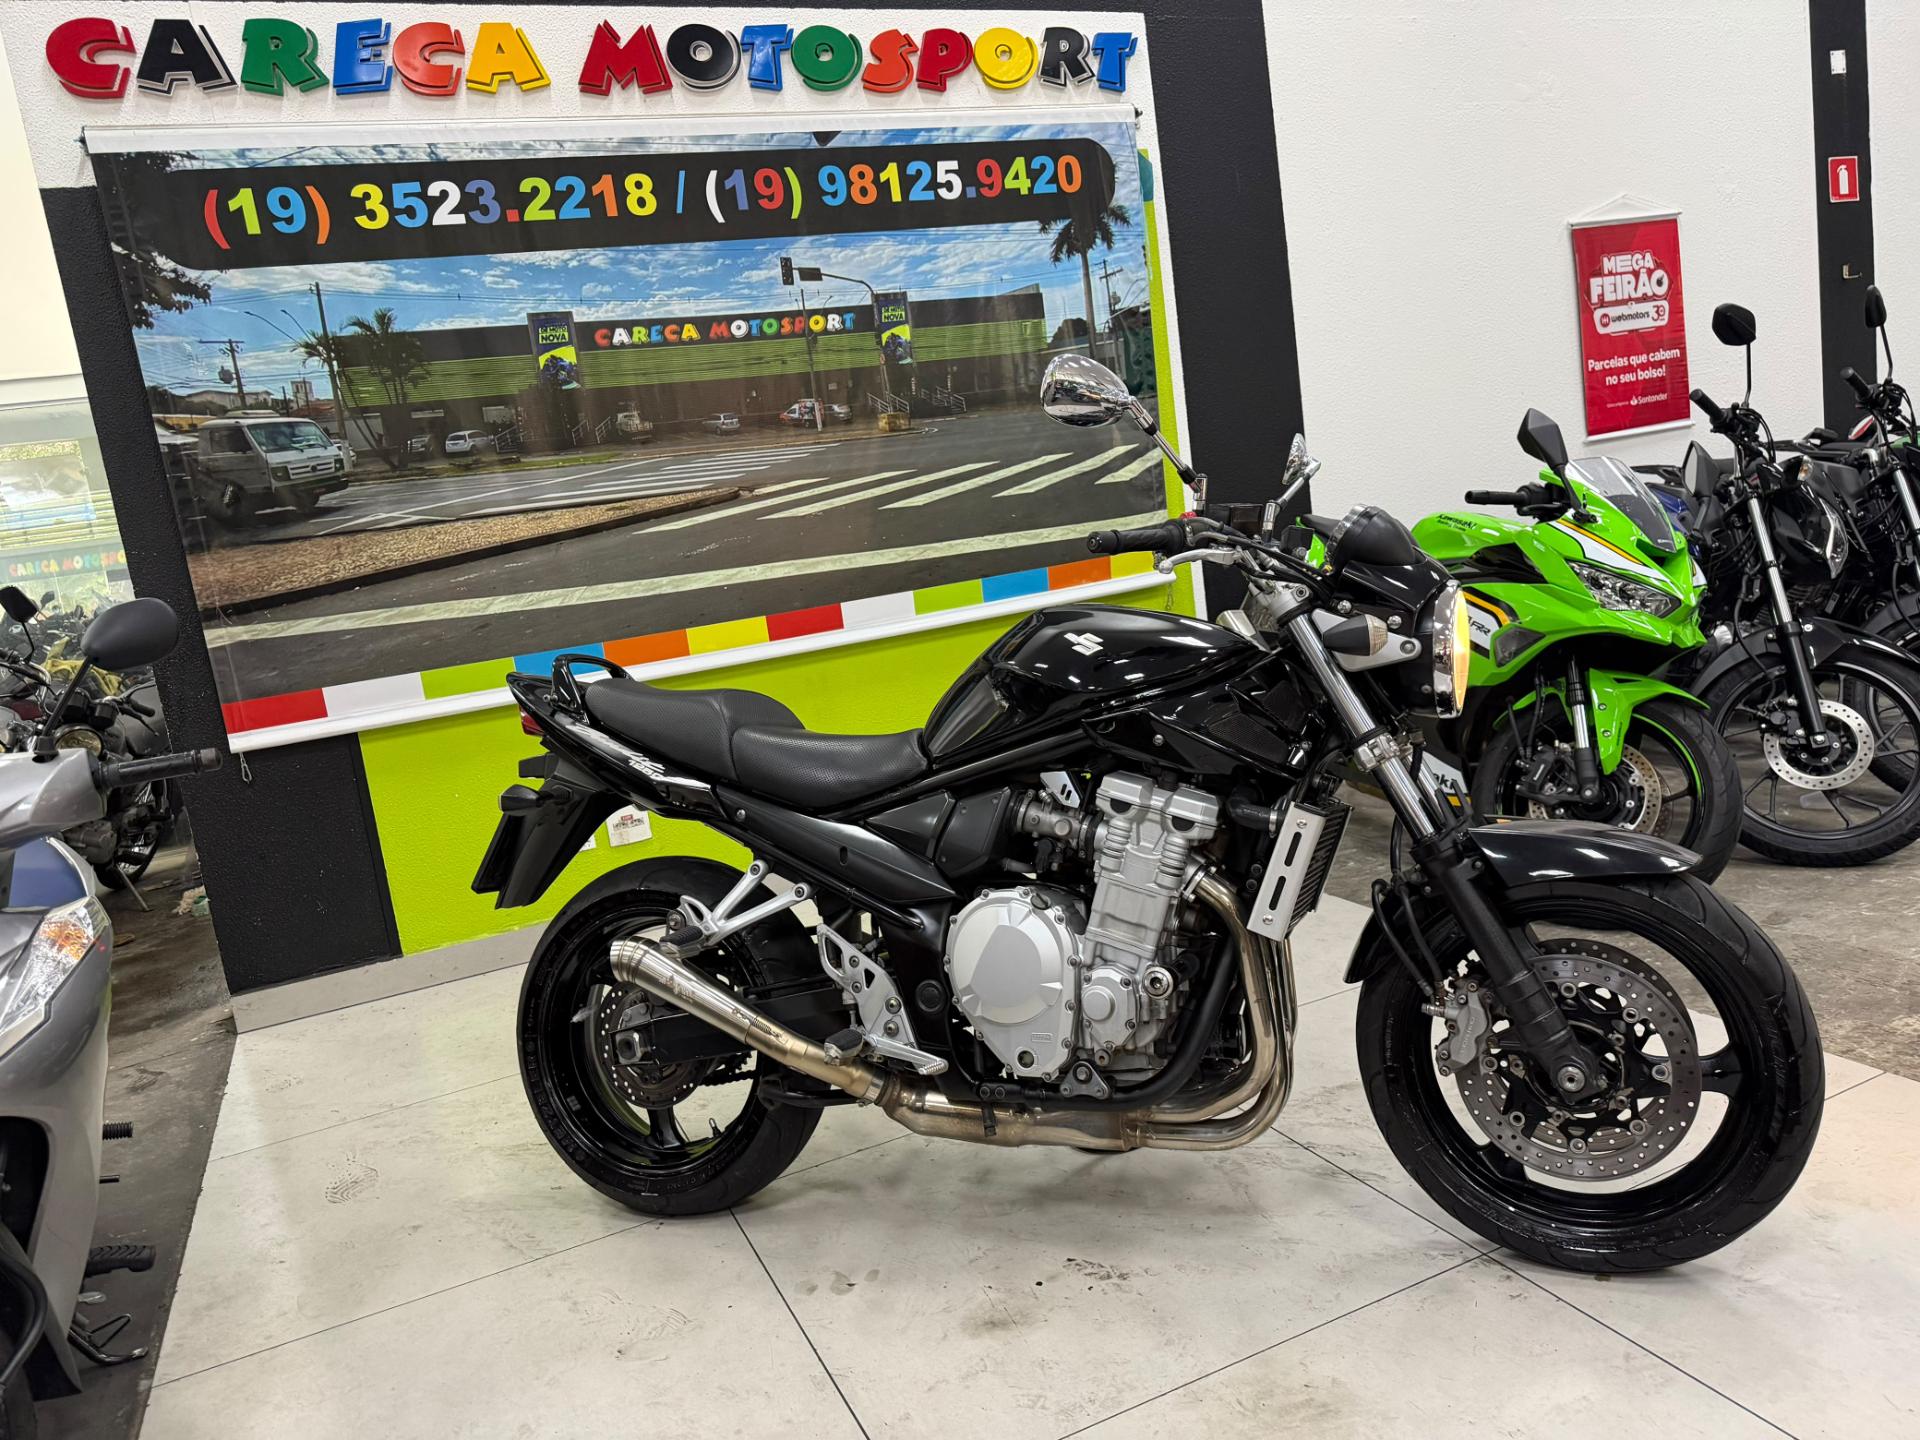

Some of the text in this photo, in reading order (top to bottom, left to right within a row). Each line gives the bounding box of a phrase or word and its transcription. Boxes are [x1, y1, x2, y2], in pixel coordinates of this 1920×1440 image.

[45, 18, 1139, 99] CARECA MOTOSPORT
[204, 154, 1083, 249] (19) 3523.2218 / (19) 98125.9420
[1603, 252, 1655, 275] MEGA
[1589, 268, 1669, 304] FEIRÃO
[1611, 310, 1650, 323] webmotors
[540, 333, 567, 343] NOVA
[594, 312, 856, 348] CARECA MOTOSPORT
[1588, 348, 1681, 372] Parcelas que cabem
[1606, 365, 1666, 386] no seu bolso!
[1638, 393, 1668, 406] Santander
